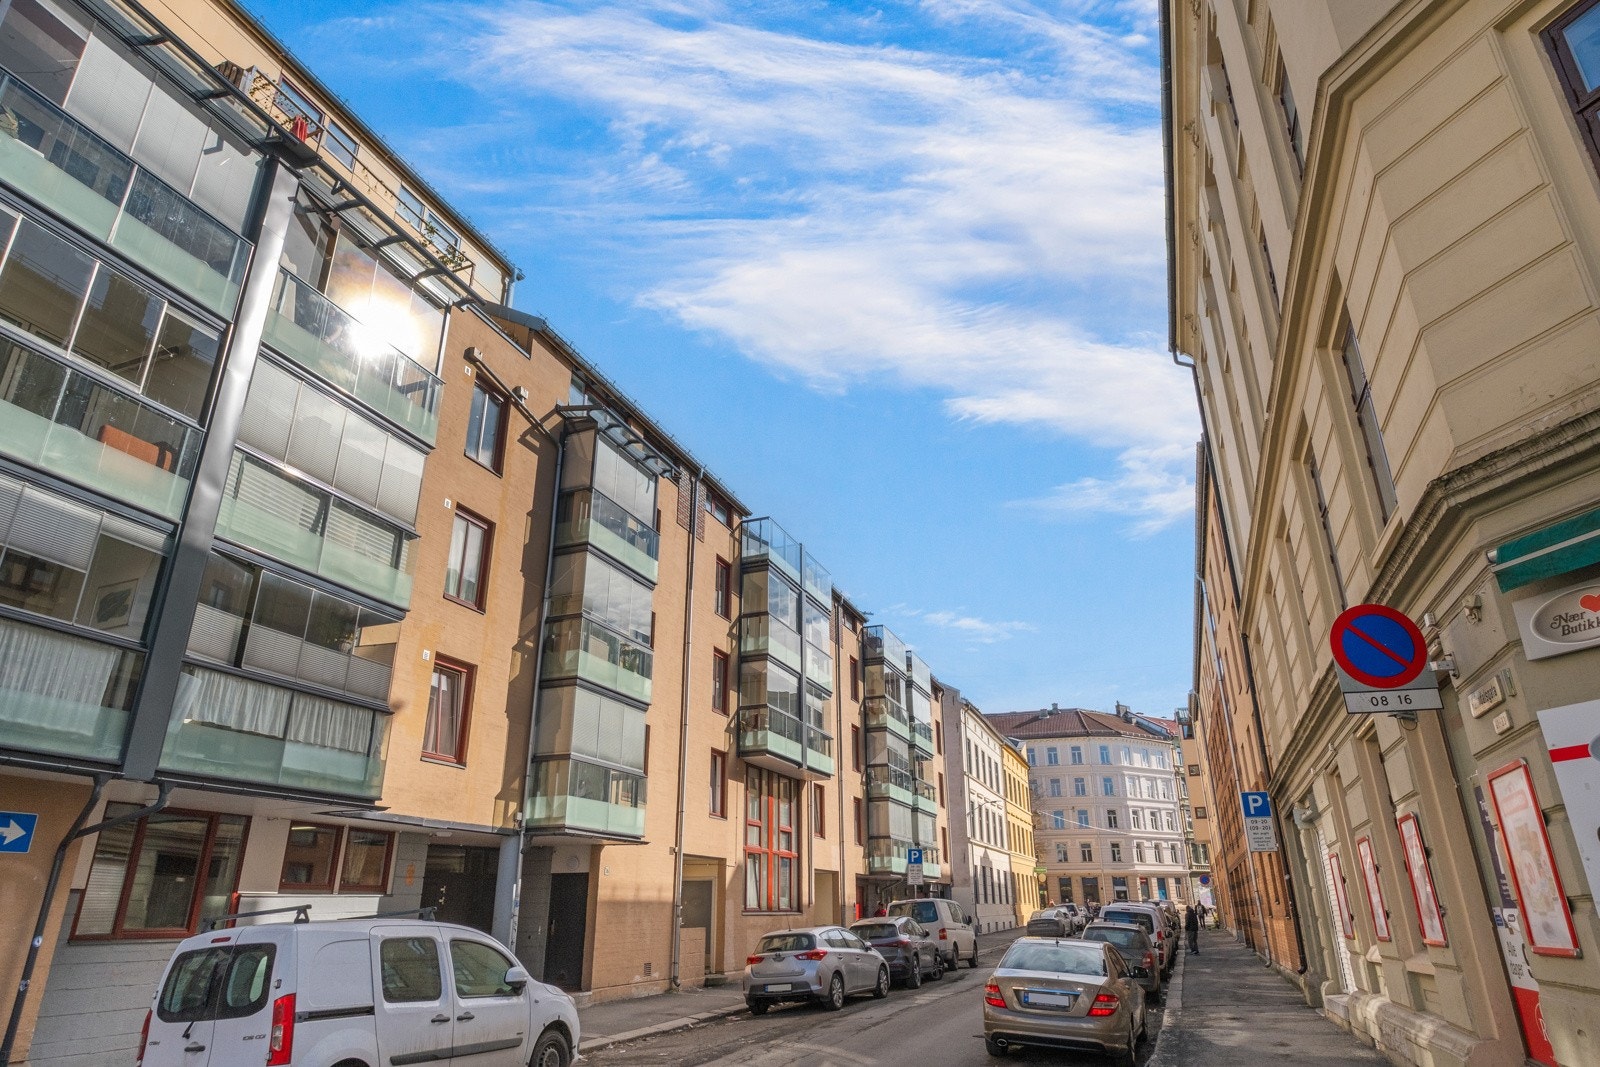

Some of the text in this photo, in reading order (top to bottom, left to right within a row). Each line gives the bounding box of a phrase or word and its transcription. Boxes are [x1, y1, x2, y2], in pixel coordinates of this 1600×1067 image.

[1550, 611, 1586, 630] Nær
[1370, 694, 1412, 707] 08 16
[1248, 795, 1263, 815] P
[911, 850, 919, 863] P
